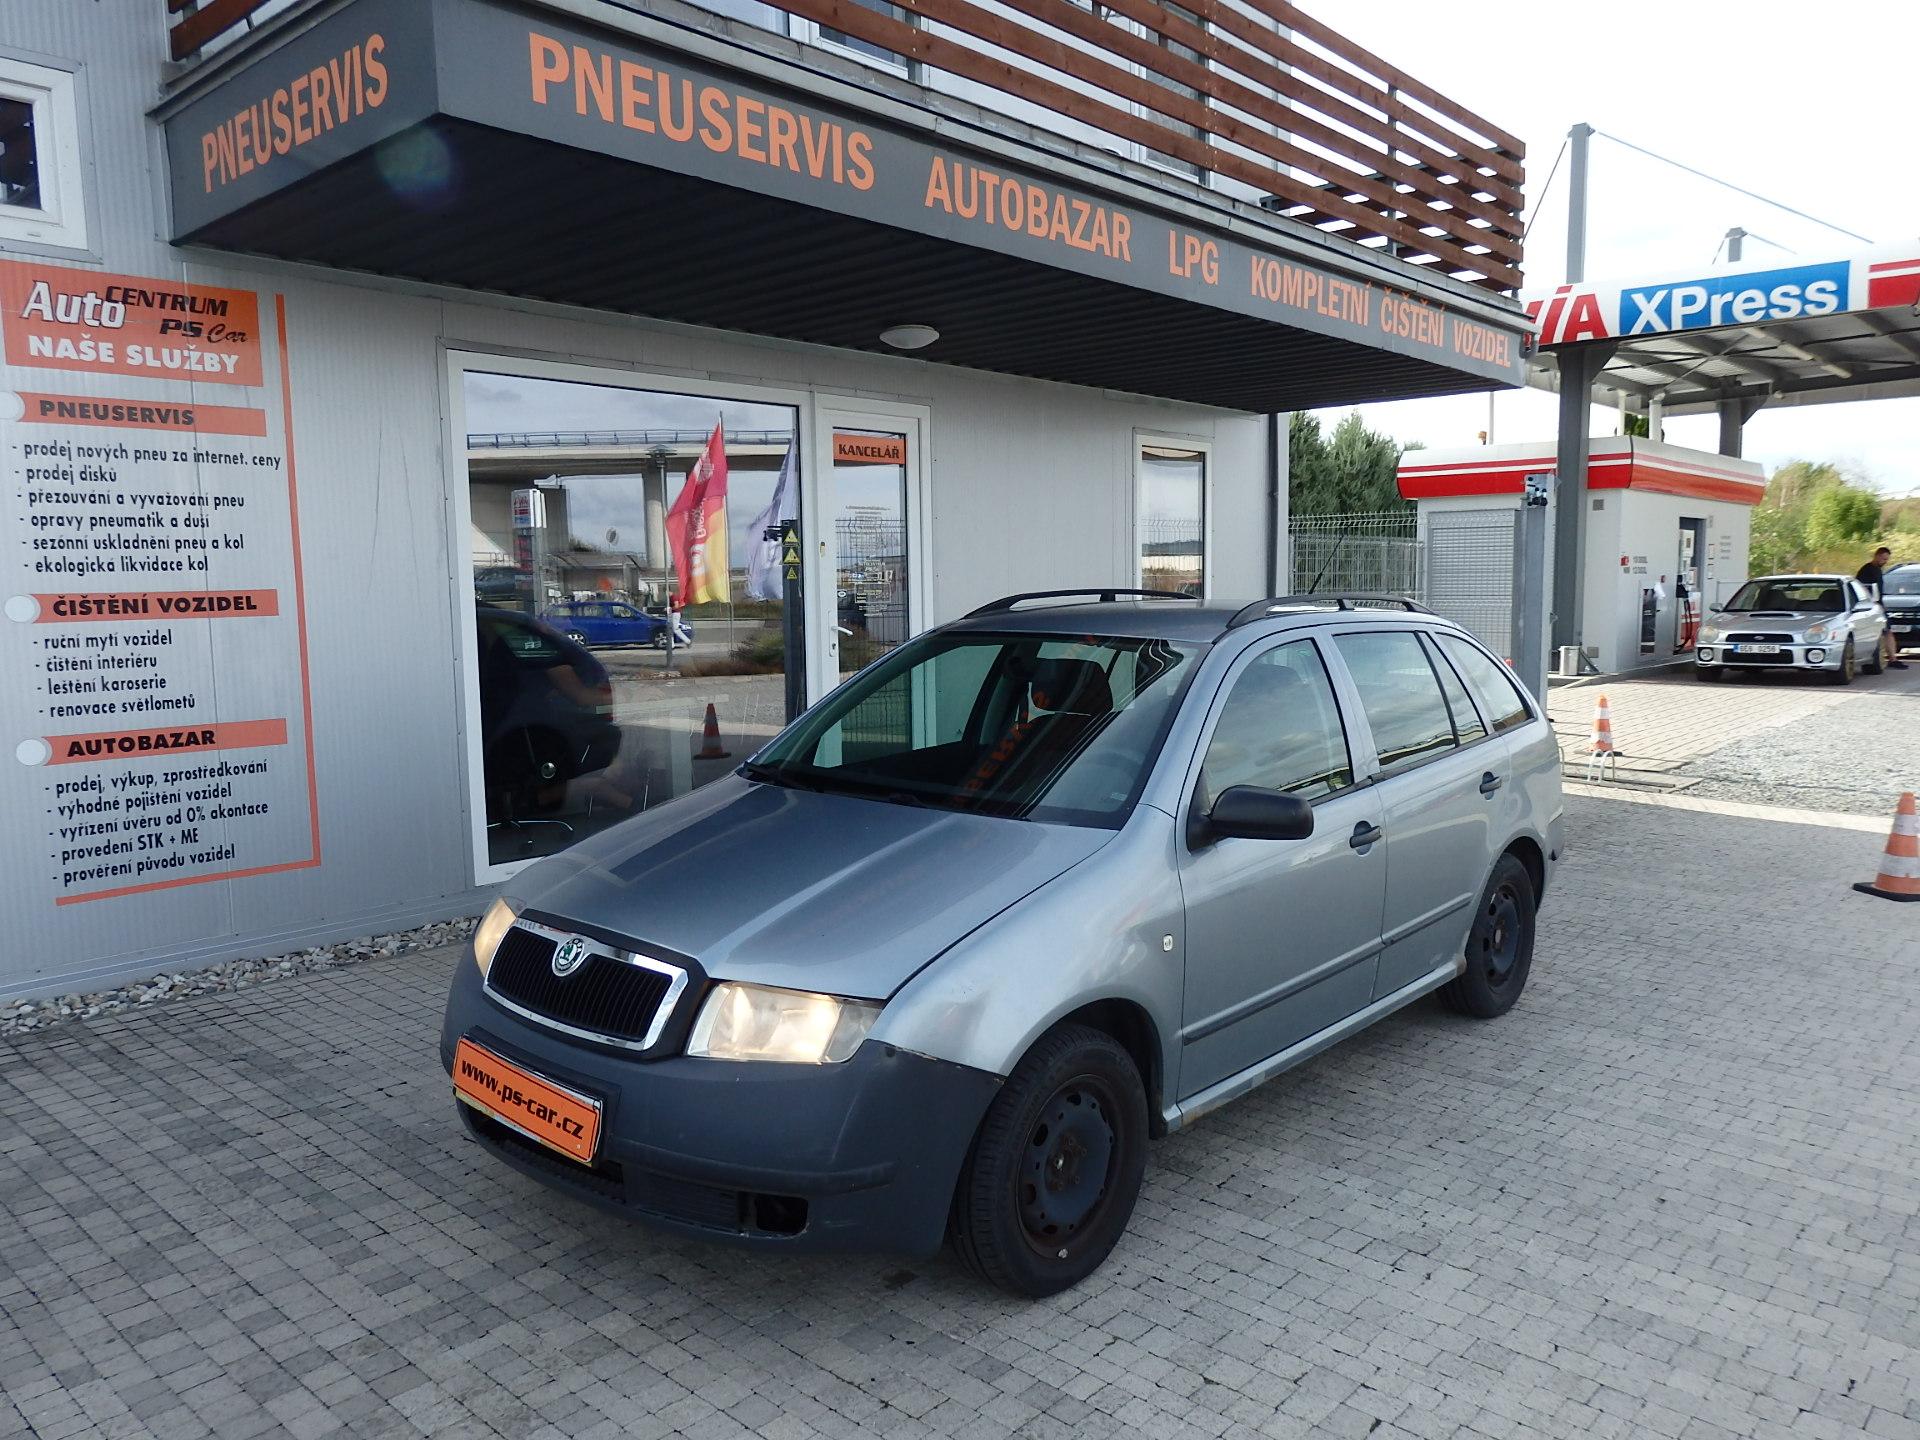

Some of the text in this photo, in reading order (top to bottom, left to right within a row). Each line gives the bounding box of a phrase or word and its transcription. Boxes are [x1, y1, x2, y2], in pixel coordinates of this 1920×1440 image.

[202, 33, 389, 193] PNEUSERVIS
[528, 32, 1511, 368] PNEUSERVIS AUTOBAZAR LPG KOMPLETNÍ ČIŠTĚNÍ VOZIDEL
[20, 280, 126, 329] Auto
[106, 286, 228, 317] CENTRUM
[1630, 280, 1840, 336] XPress
[160, 319, 249, 344] PS Car
[28, 333, 239, 374] NAŠE SLUŽBY
[40, 399, 195, 426] PNEUSERVIS
[24, 440, 72, 461] prodej
[77, 443, 128, 463] nových
[134, 449, 166, 464] pneu
[172, 451, 188, 462] za
[252, 455, 281, 470] ceny
[838, 443, 900, 459] KANCELÁŘ
[26, 464, 74, 485] prodej
[29, 488, 245, 510] přezouvání a vyvažování pneu
[31, 515, 83, 531] opravy
[89, 512, 165, 531] pneumatik
[170, 518, 178, 528] a
[175, 539, 207, 554] pneu
[212, 540, 219, 549] a
[224, 534, 244, 549] kol
[35, 555, 208, 577] ekologická likvidace kol
[53, 594, 257, 616] ČIŠTĚNÍ VOZIDEL
[44, 629, 172, 651] ruční mytí vozidel
[46, 653, 157, 672] čištění interiéru
[48, 673, 167, 695] leštění karoserie
[50, 694, 195, 718] renovace světlometů
[67, 731, 216, 757] AUTOBAZAR
[58, 782, 231, 820] výhodné pojištění vozidel
[60, 803, 268, 842] vyřízení úvěru od 0% akontace
[62, 838, 133, 865] provedení
[137, 832, 163, 851] STK
[181, 828, 199, 844] ME
[64, 843, 235, 887] prověření původu vozidel
[461, 1060, 585, 1140] www.ps-car.cz
